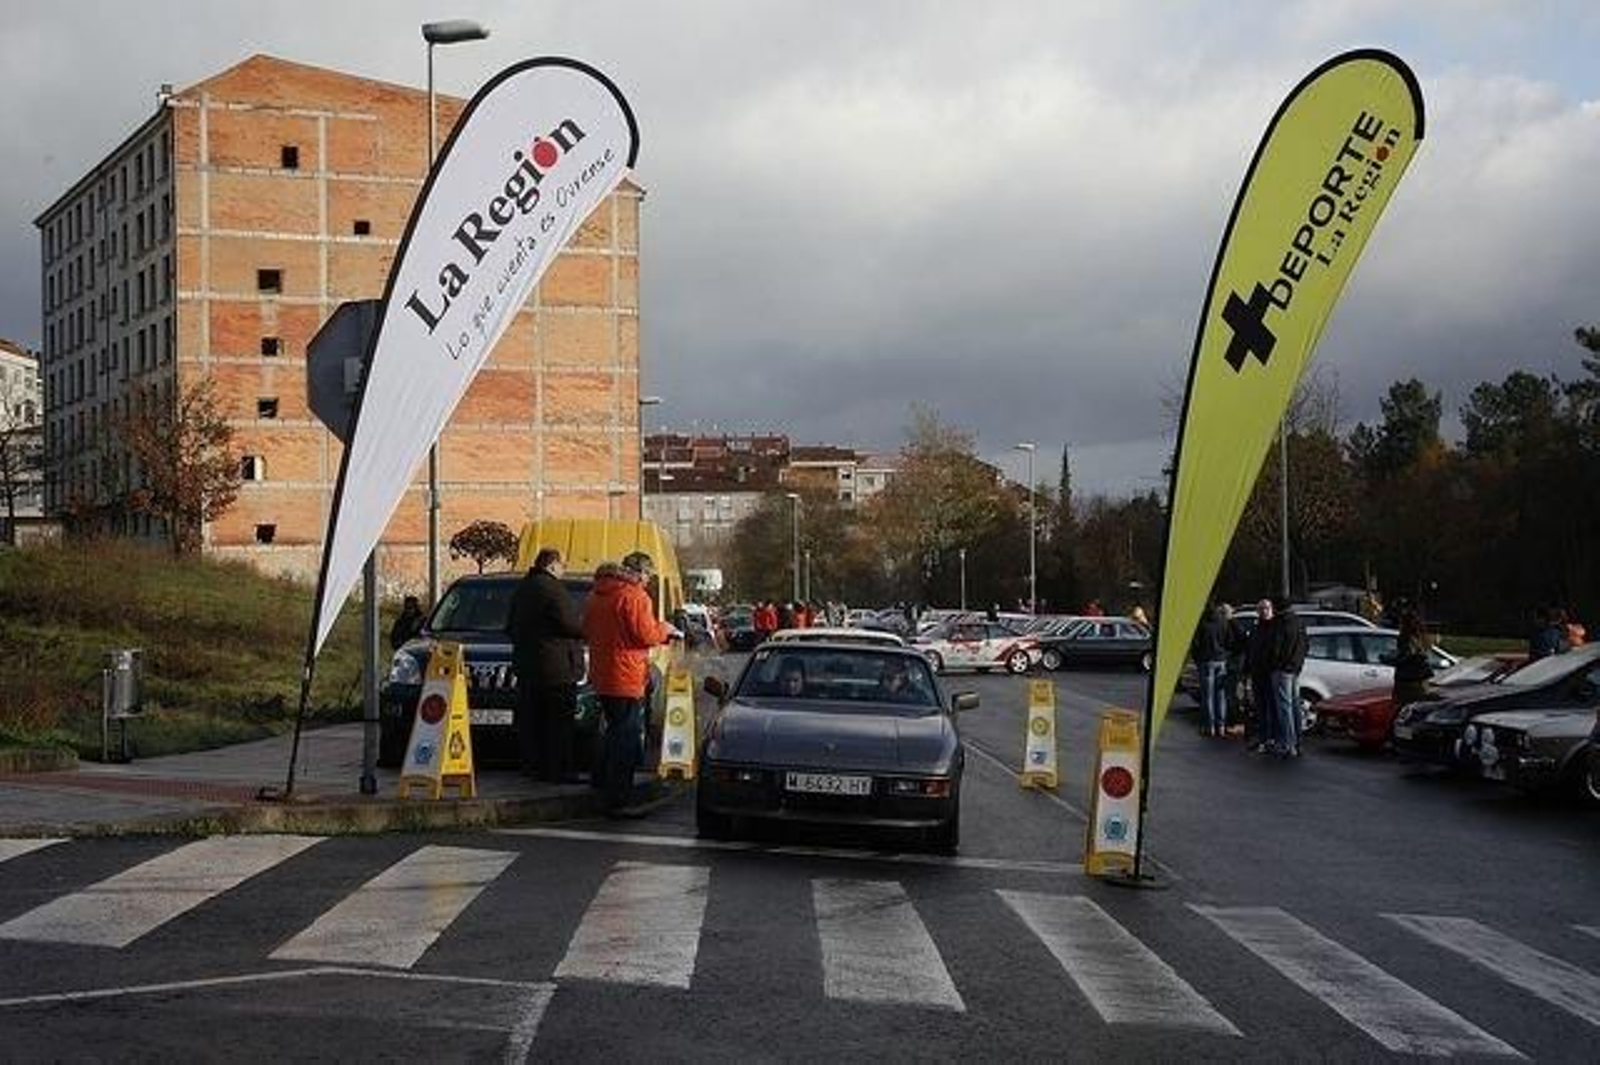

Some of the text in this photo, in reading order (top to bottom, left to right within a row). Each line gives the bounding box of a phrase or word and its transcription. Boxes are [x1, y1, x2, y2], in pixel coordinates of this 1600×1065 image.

[1316, 229, 1345, 267] La
[404, 262, 470, 335] La
[446, 332, 470, 360] Lo
